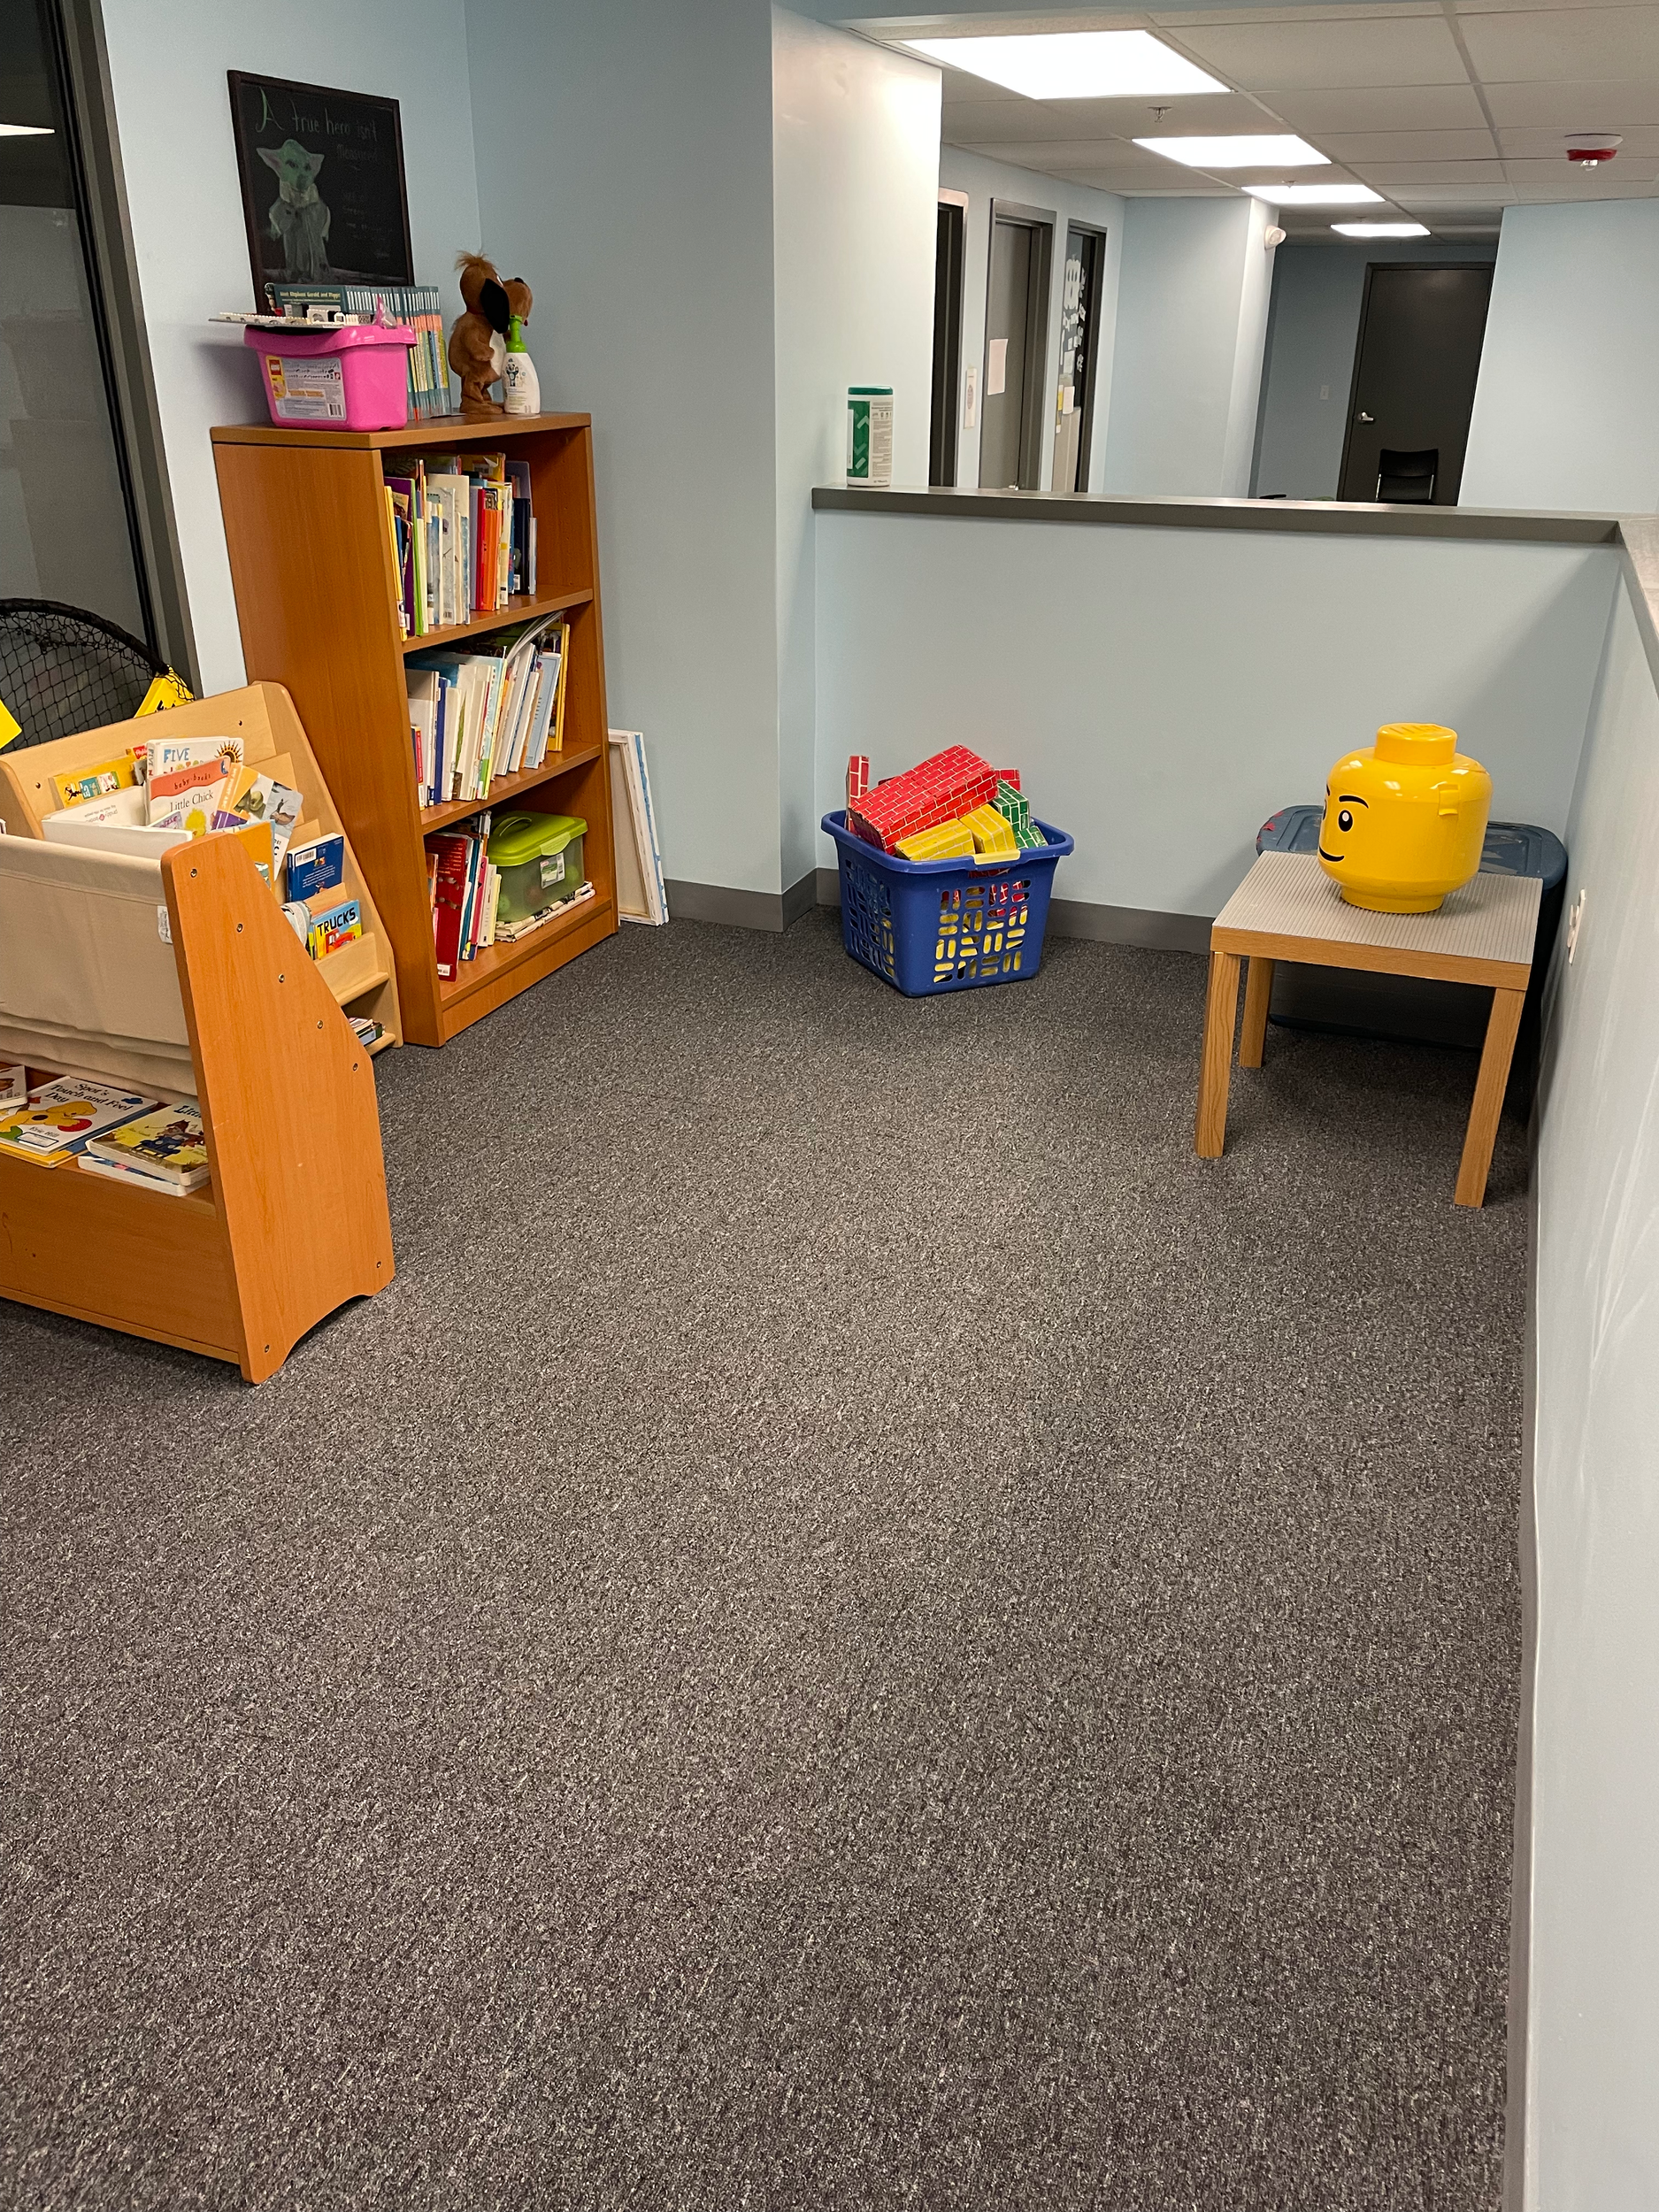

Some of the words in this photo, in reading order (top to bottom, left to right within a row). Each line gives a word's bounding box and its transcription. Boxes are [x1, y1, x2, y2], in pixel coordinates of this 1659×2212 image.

[255, 86, 286, 133] A
[289, 97, 320, 133] true
[325, 107, 350, 135] hero
[164, 748, 190, 764] FIVE
[173, 779, 189, 790] baby
[170, 797, 189, 812] Little
[191, 789, 214, 805] Chick
[317, 907, 356, 937] TRUCKS
[45, 1092, 70, 1103] Day
[50, 1084, 84, 1098] Touch
[83, 1095, 109, 1104] and
[104, 1100, 134, 1111] Feel
[74, 1083, 110, 1096] Spot's
